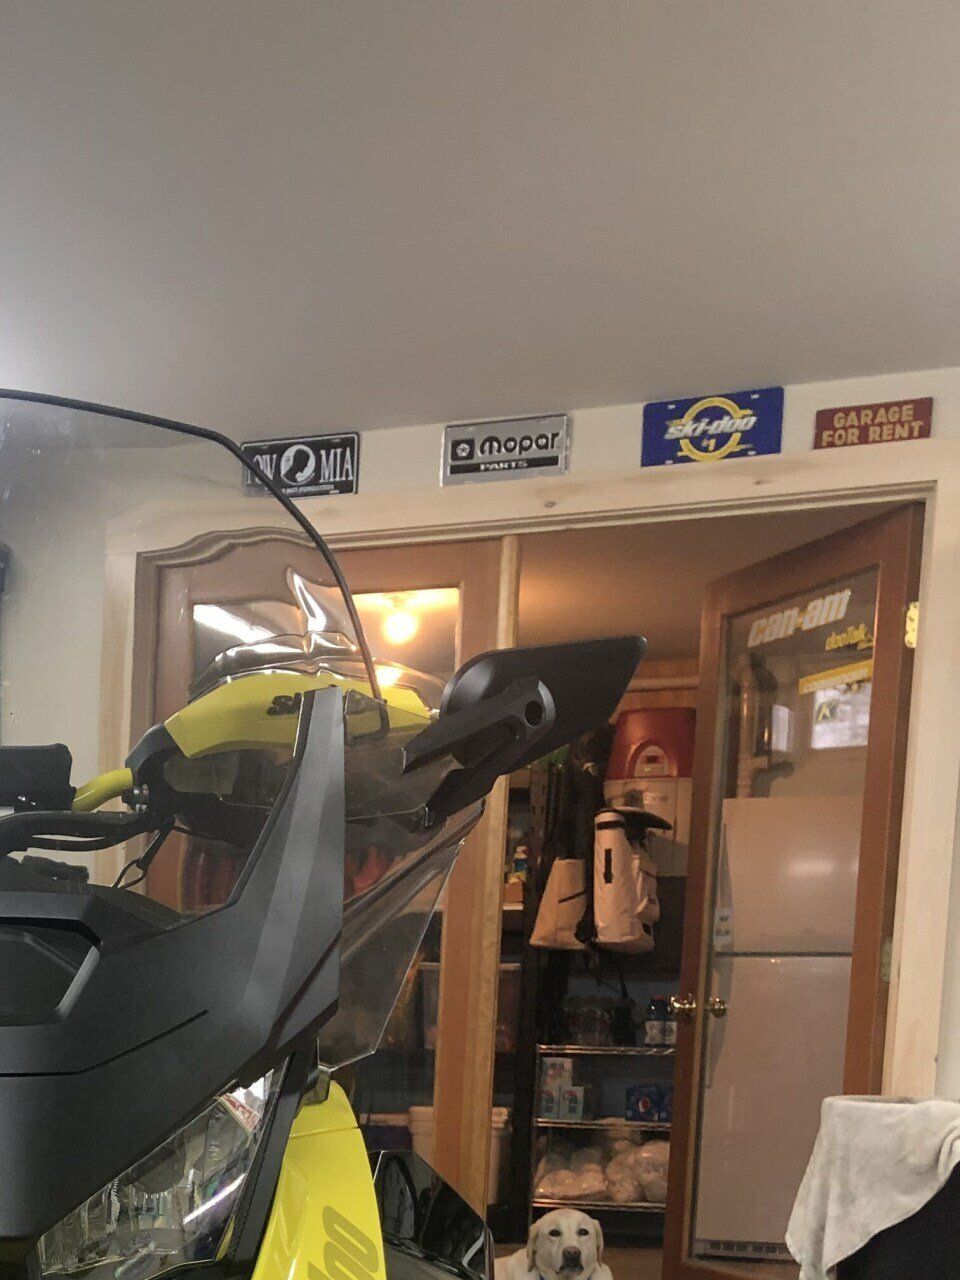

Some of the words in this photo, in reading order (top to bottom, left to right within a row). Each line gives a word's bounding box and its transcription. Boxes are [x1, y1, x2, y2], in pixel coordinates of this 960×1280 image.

[833, 404, 914, 428] GARAGE
[822, 428, 859, 447] FOR
[868, 421, 924, 442] RENT
[319, 446, 354, 483] MIA
[480, 461, 529, 471] PARTS
